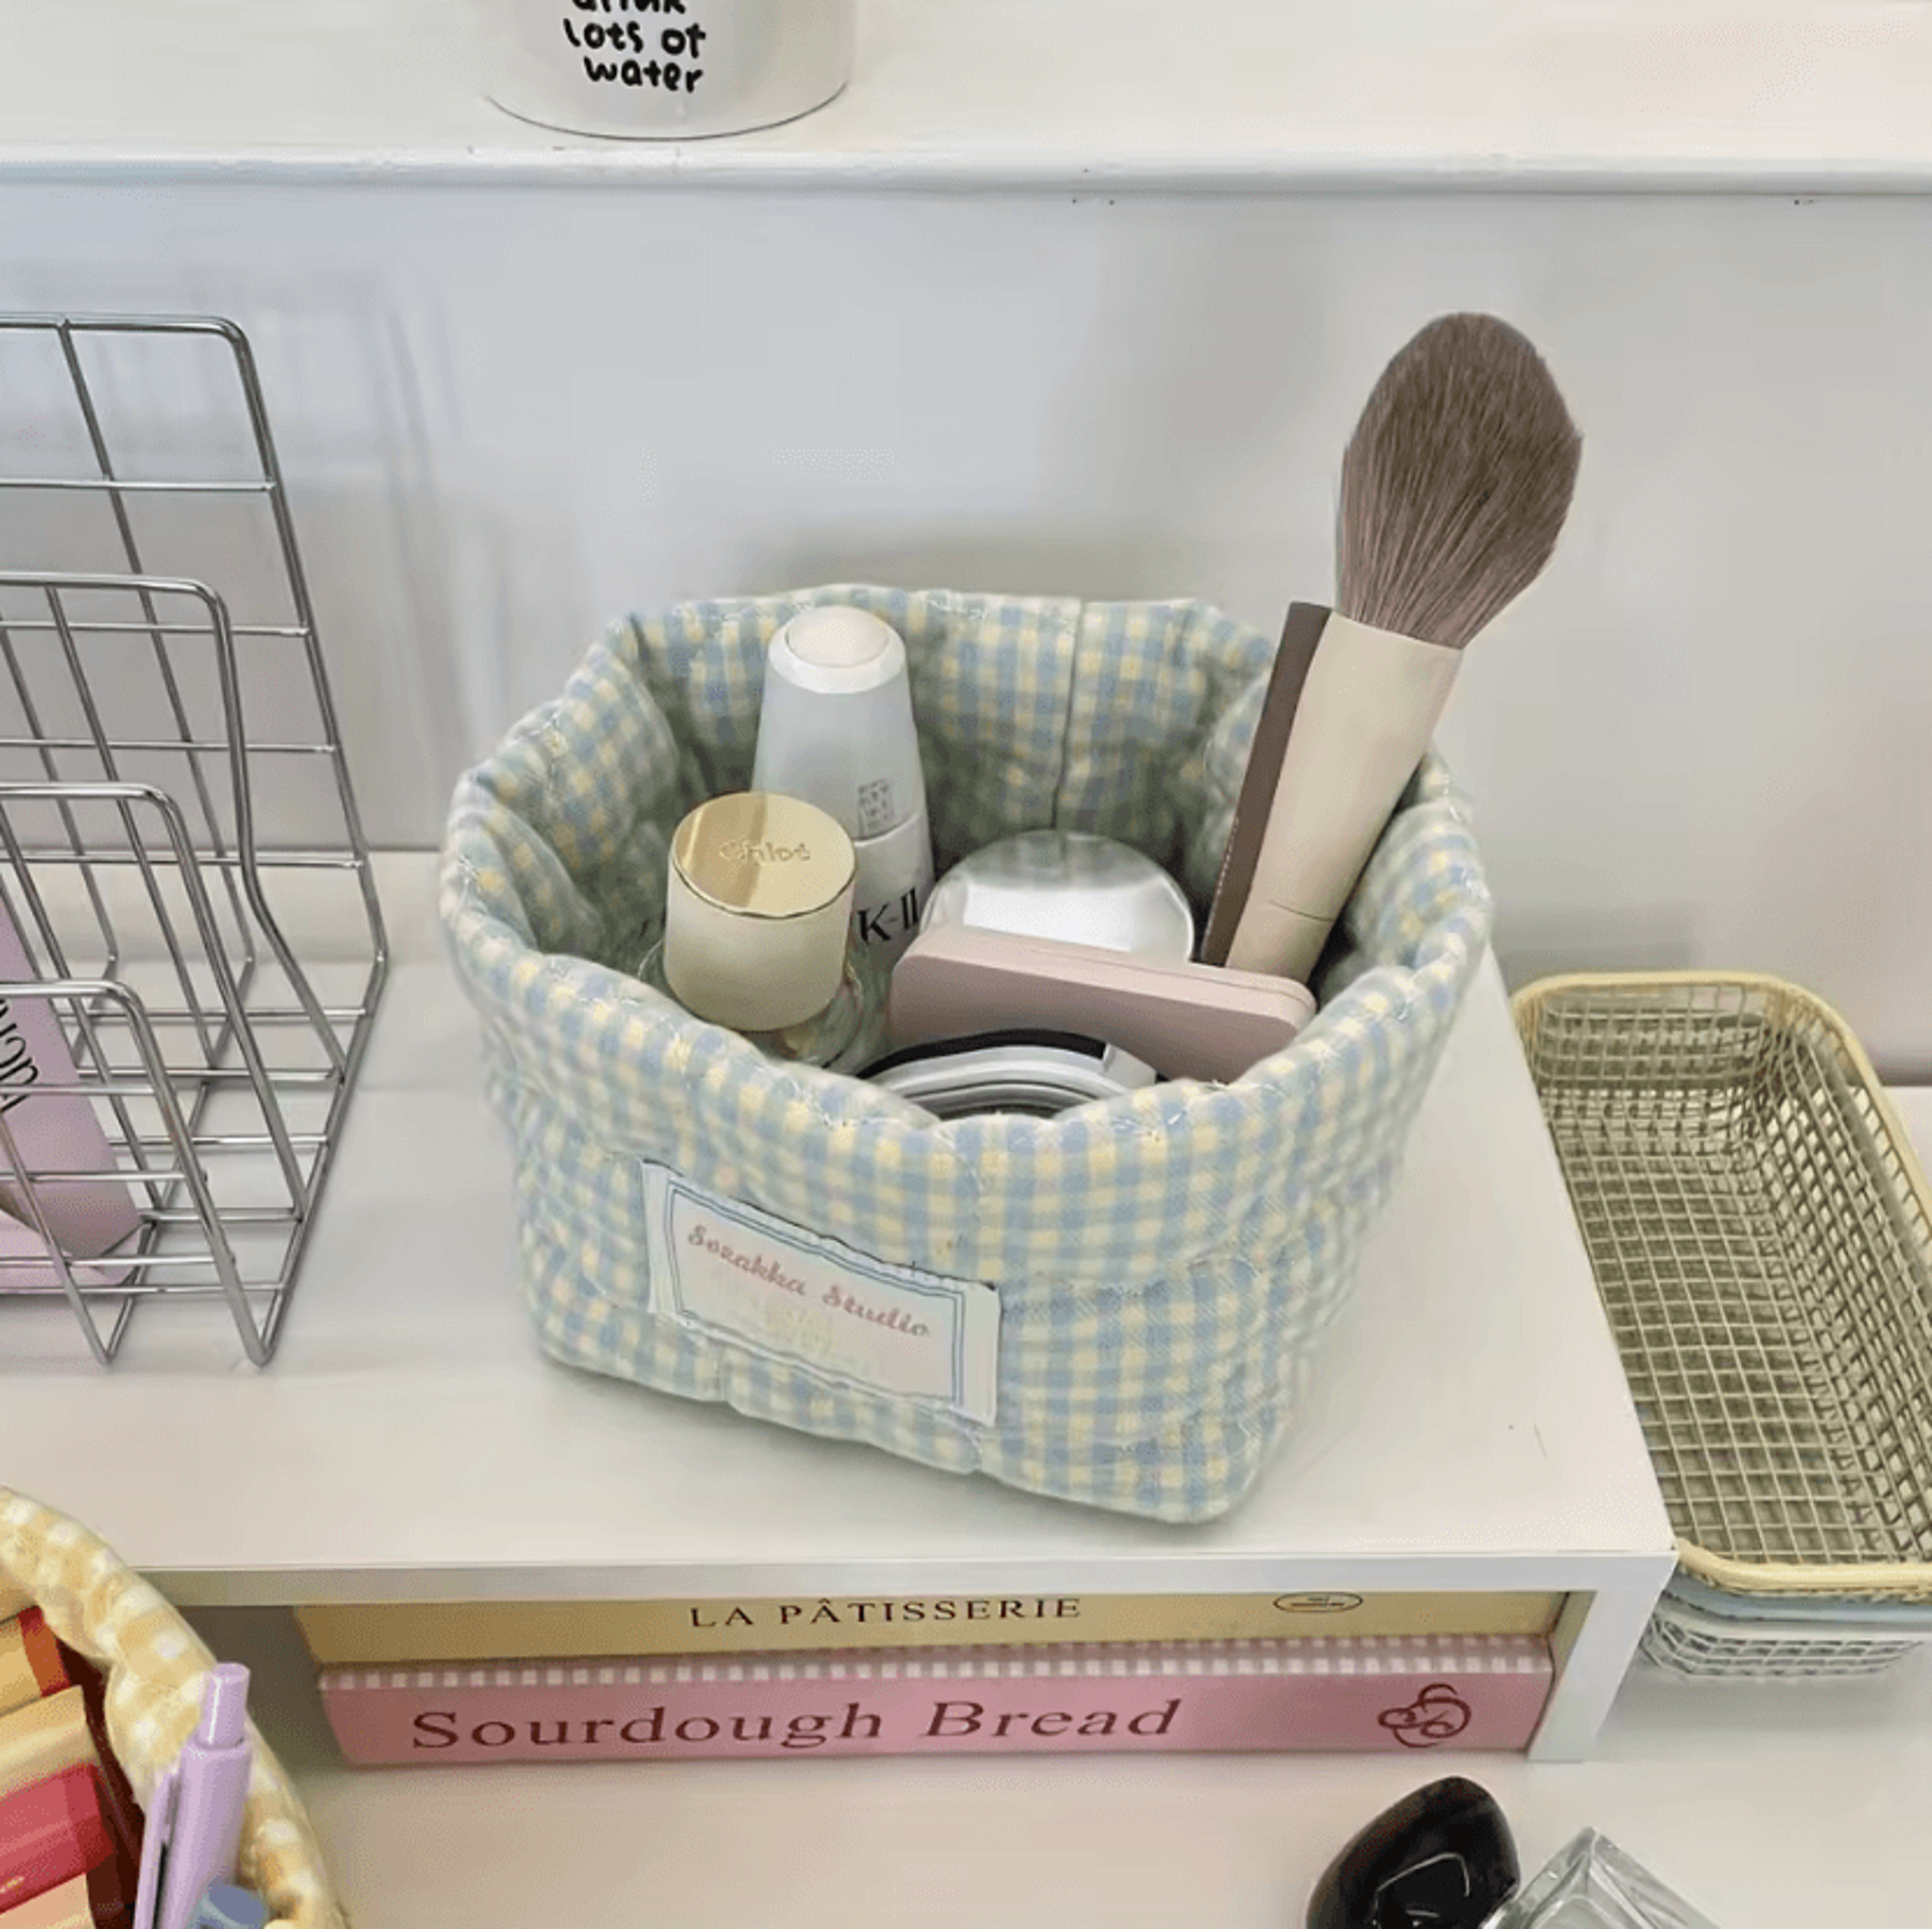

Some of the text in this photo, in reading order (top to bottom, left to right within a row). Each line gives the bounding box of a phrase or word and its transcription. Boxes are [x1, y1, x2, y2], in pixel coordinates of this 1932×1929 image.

[563, 18, 643, 53] lots
[583, 55, 704, 94] water
[822, 1285, 932, 1337] Studio
[691, 1598, 1081, 1627] LA PÂTISSERIE
[412, 1698, 1182, 1748] Sourdough Bread
